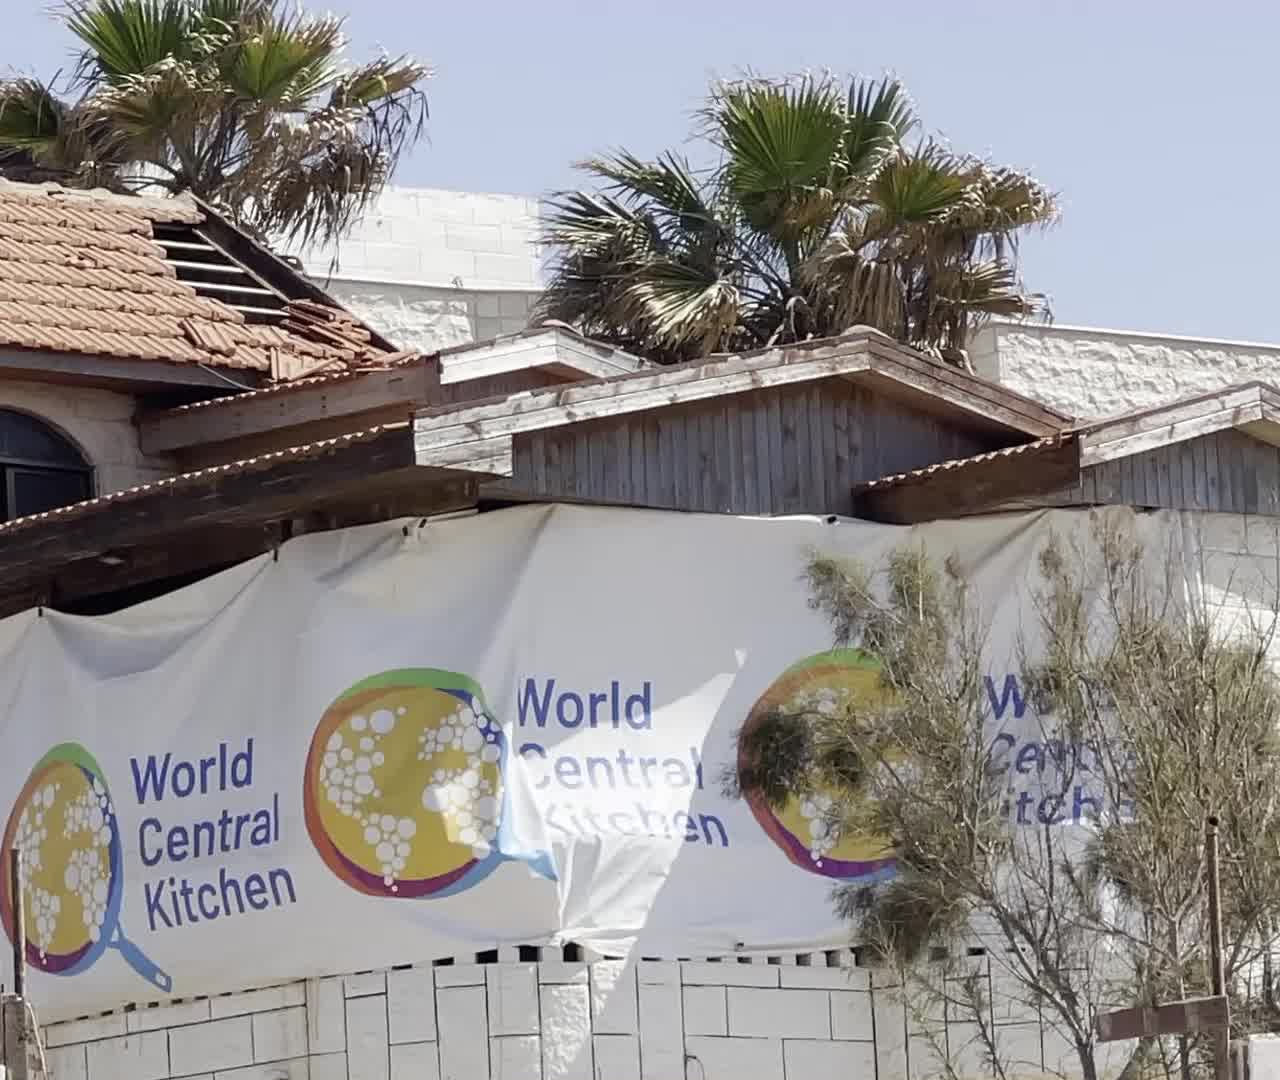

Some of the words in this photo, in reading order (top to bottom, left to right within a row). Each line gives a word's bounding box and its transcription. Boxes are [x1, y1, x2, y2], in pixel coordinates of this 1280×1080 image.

[516, 677, 653, 730] World
[130, 737, 254, 805] World
[138, 793, 279, 867] Central
[144, 867, 297, 932] Kitchen
